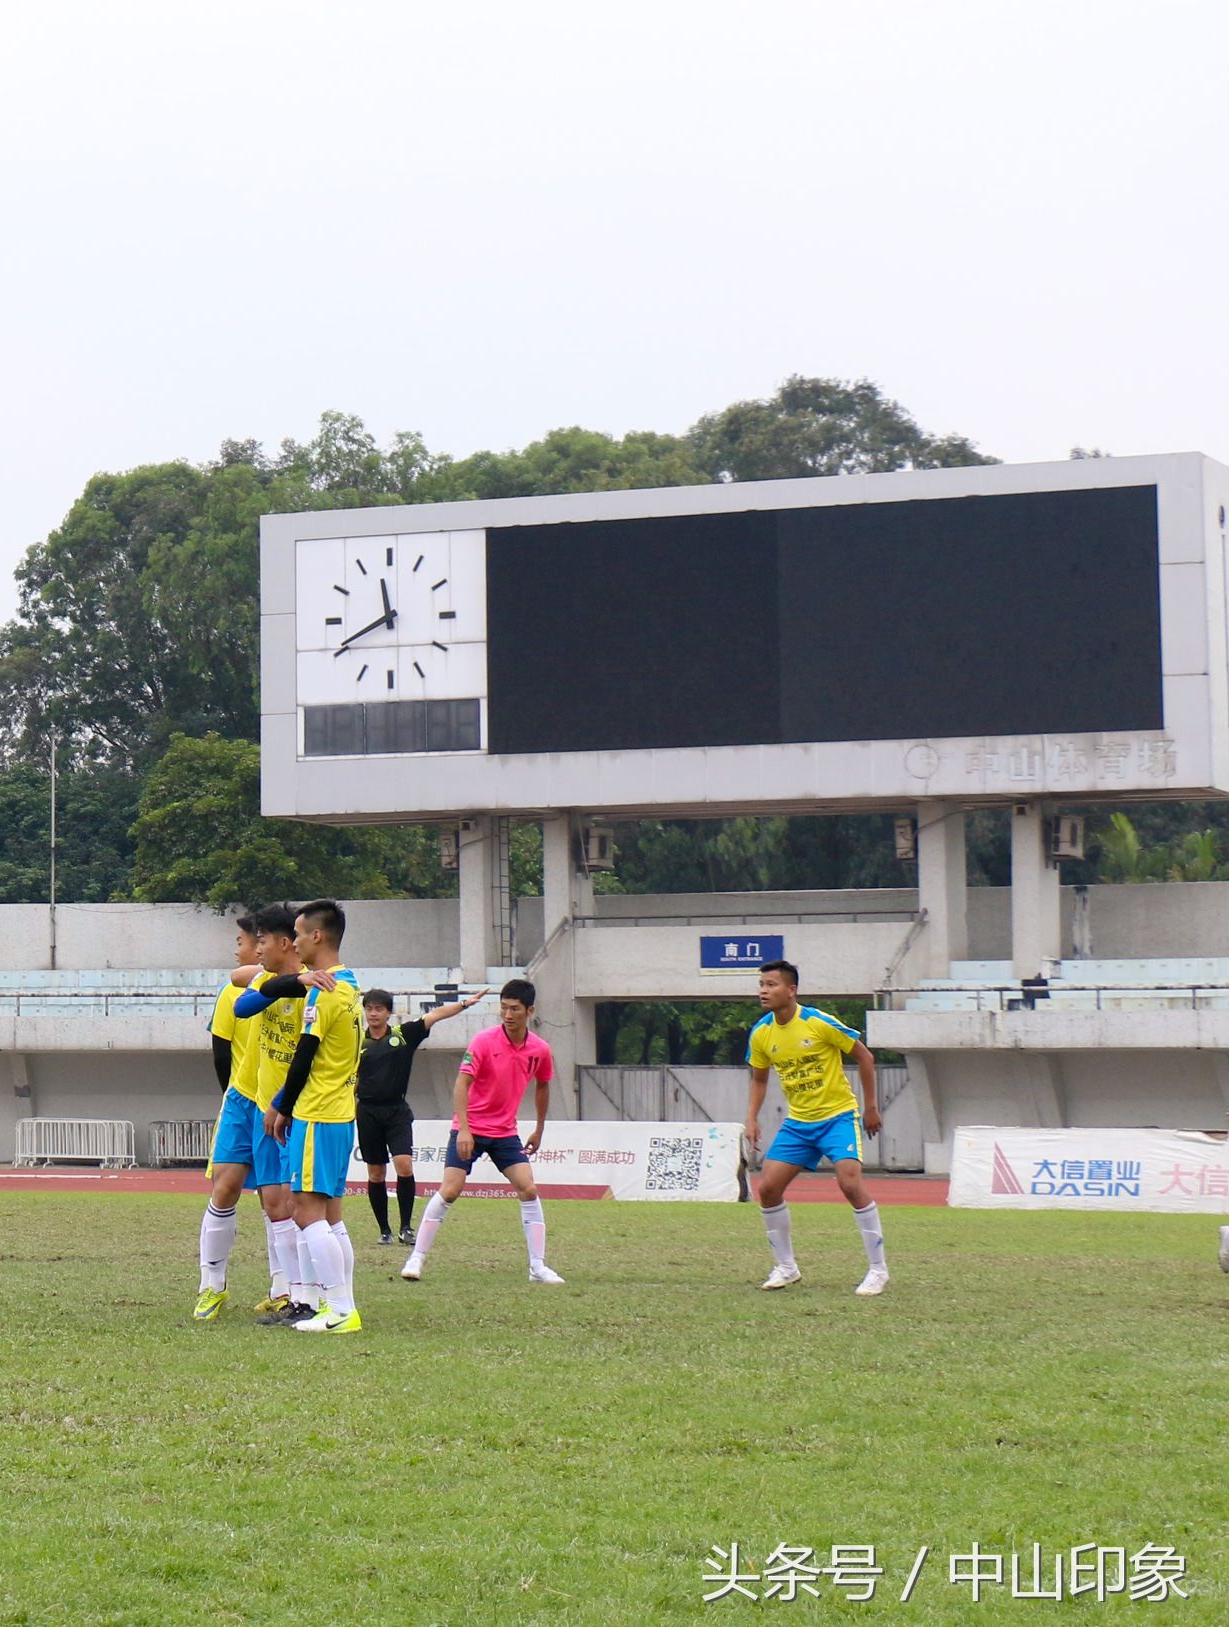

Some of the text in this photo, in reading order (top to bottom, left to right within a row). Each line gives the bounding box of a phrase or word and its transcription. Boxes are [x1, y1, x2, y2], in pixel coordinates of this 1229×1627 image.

[724, 942, 759, 957] 南门
[527, 1055, 539, 1074] 11
[578, 1149, 635, 1165] 圆满成功
[1032, 1158, 1229, 1197] 大信置业 大信
[1030, 1182, 1140, 1197] DASIN
